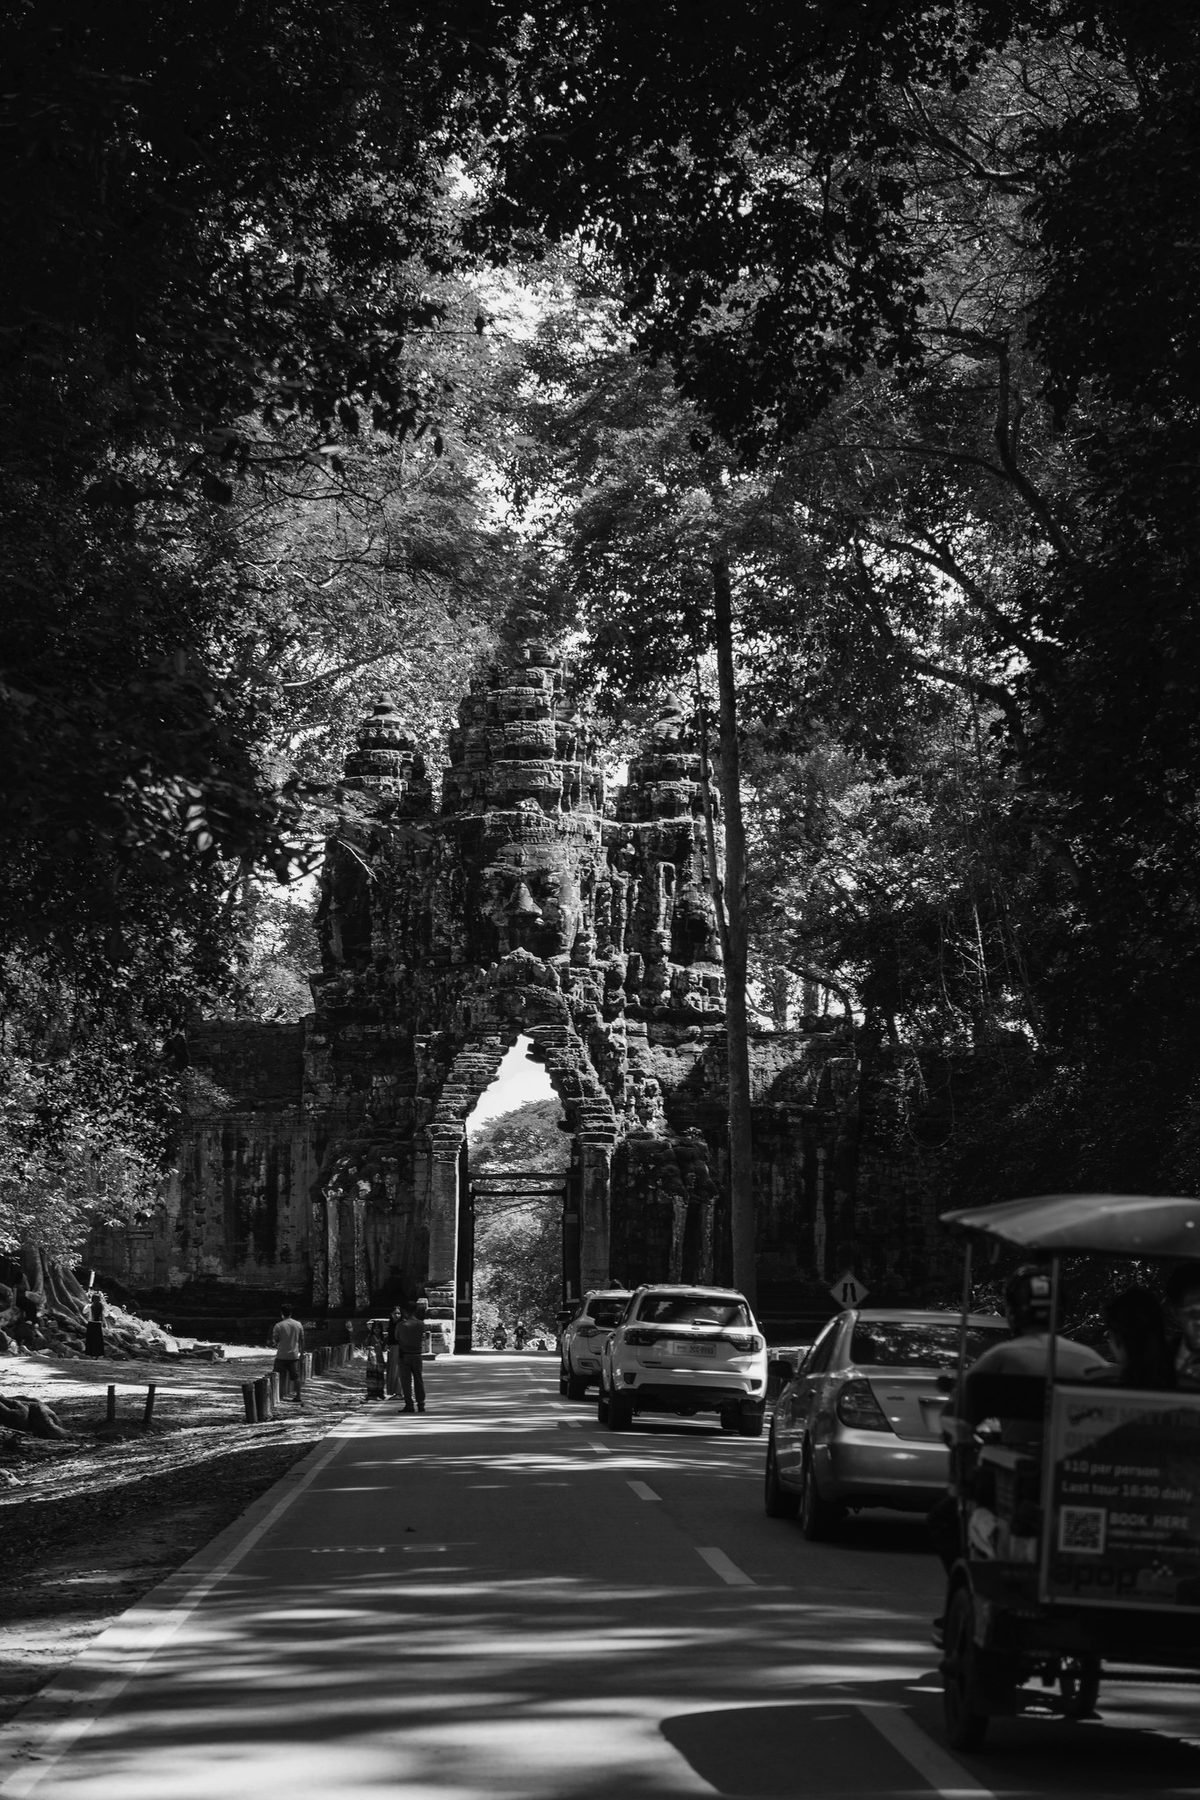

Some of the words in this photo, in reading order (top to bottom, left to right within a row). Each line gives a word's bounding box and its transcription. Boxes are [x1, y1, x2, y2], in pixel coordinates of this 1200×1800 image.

[1090, 1463, 1112, 1477] per
[1113, 1465, 1160, 1478] person
[1061, 1480, 1089, 1494] Last
[1161, 1486, 1193, 1502] daily
[1109, 1512, 1147, 1526] BOOK
[1153, 1514, 1189, 1530] HERE
